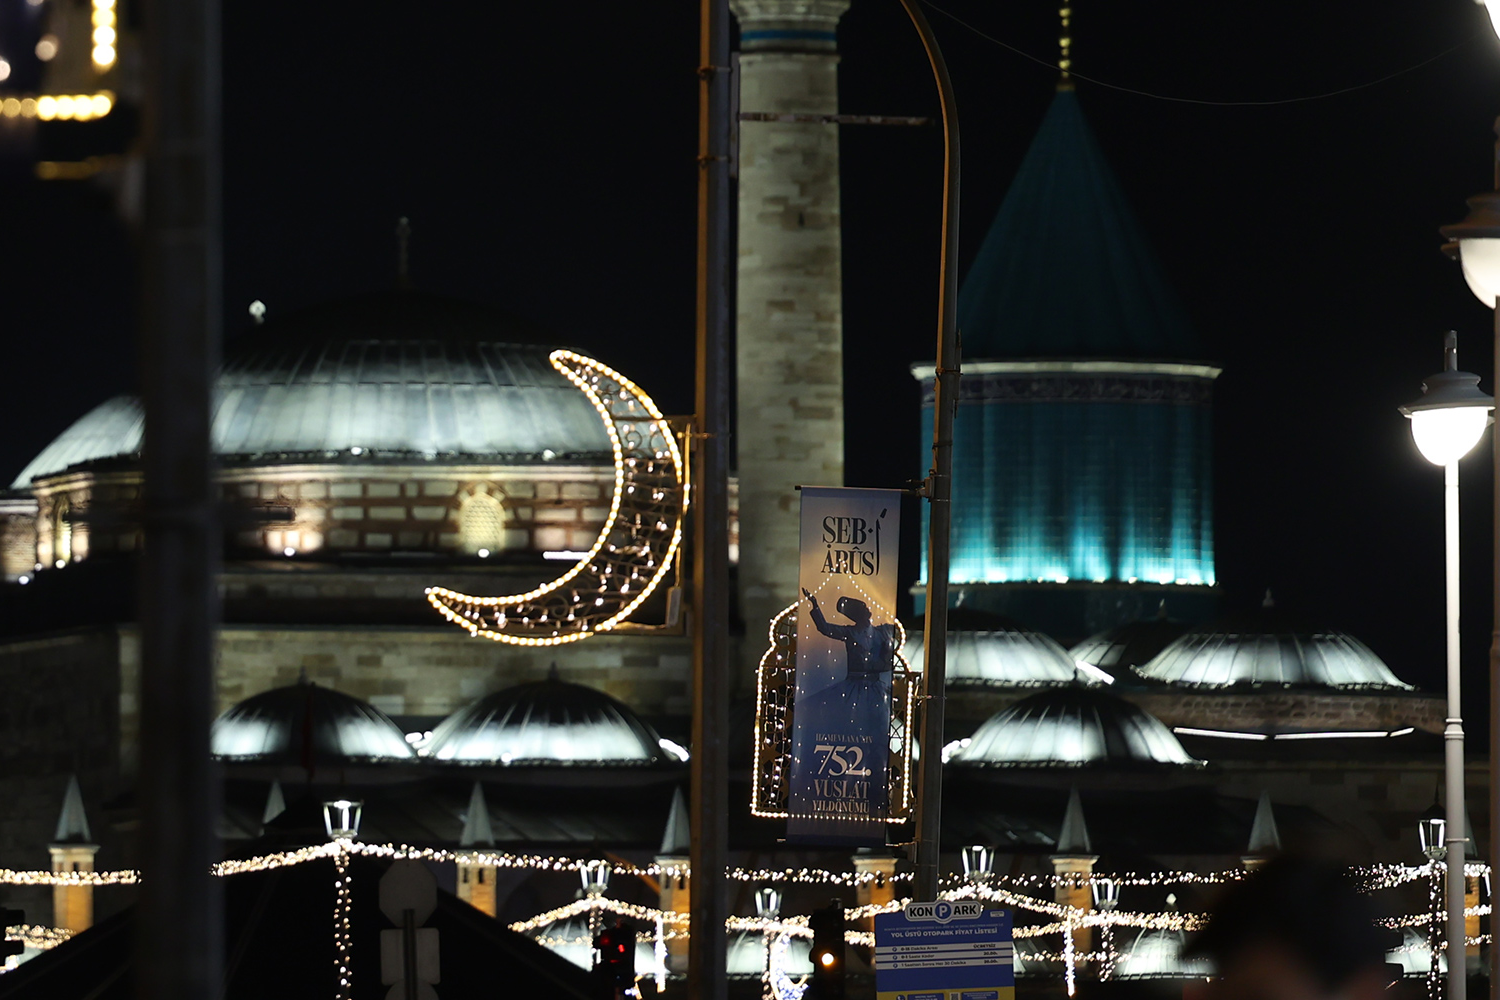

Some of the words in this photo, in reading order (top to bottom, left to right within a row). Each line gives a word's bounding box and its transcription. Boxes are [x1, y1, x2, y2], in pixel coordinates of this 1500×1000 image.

[813, 744, 872, 777] 752.
[813, 778, 871, 799] VUSLAT
[812, 798, 870, 814] YILDÖNÜMÜ
[905, 930, 921, 938] ÜSTÜ
[923, 929, 954, 937] OTOPARK
[974, 926, 998, 935] LİSTESİ
